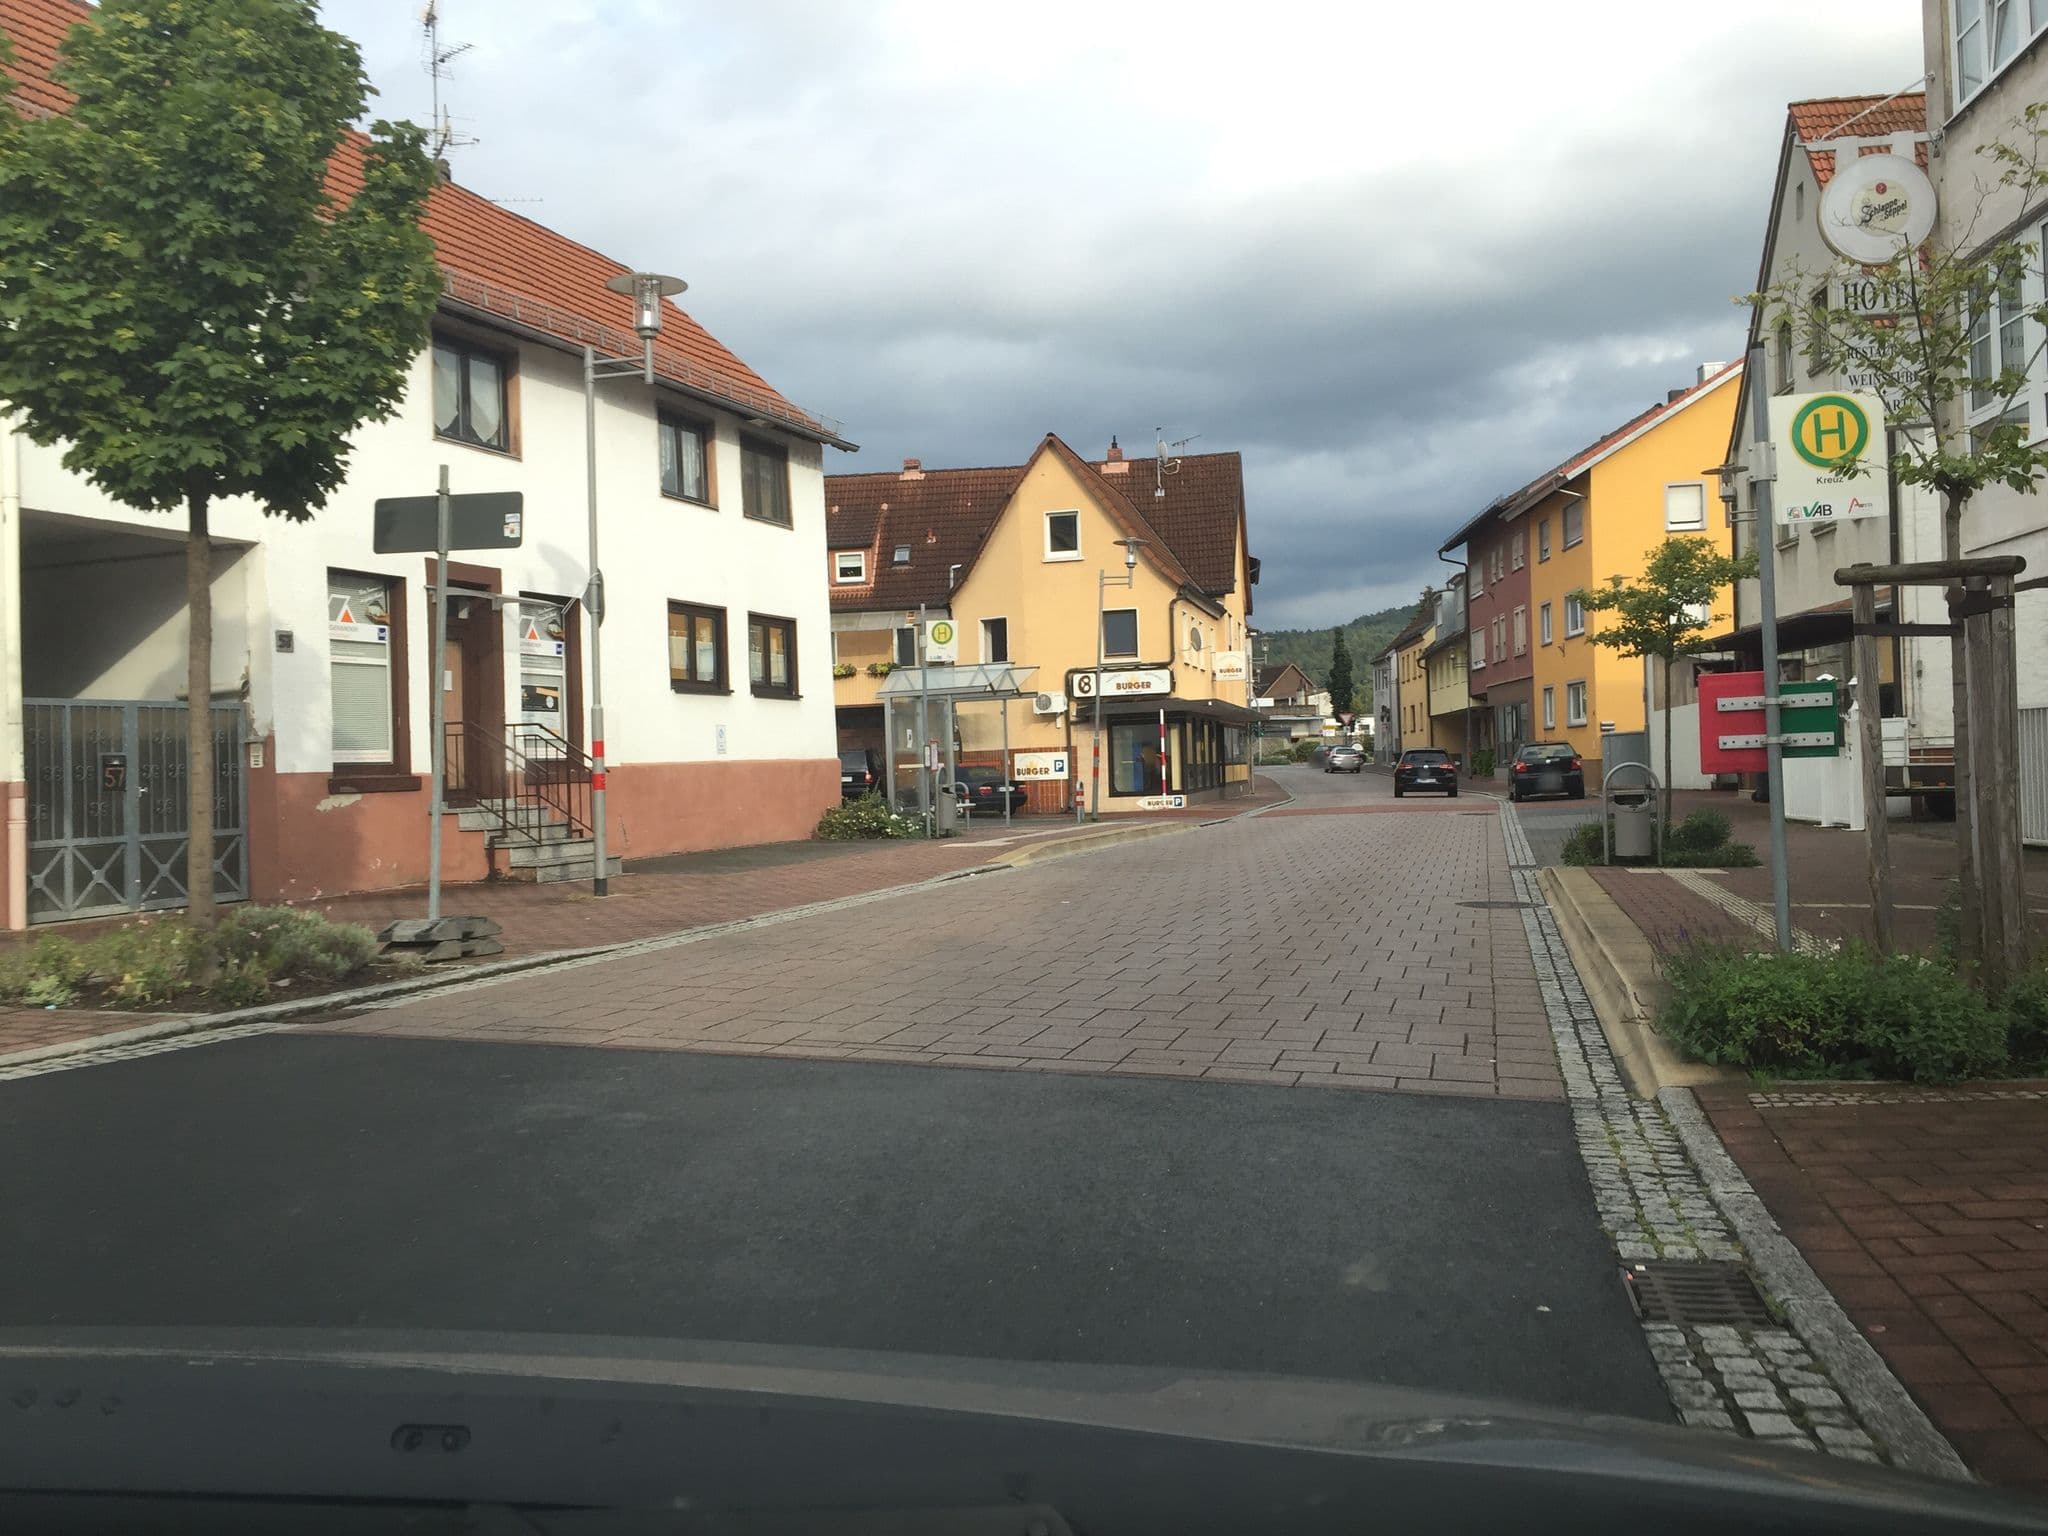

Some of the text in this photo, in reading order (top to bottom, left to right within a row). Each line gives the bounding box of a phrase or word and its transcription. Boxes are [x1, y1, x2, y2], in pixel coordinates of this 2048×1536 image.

[1814, 411, 1846, 453] H
[1816, 476, 1844, 485] Kreuz
[1803, 501, 1833, 518] VAB
[1116, 681, 1152, 691] BURGER
[105, 767, 125, 788] 57
[1016, 767, 1050, 776] BURGER
